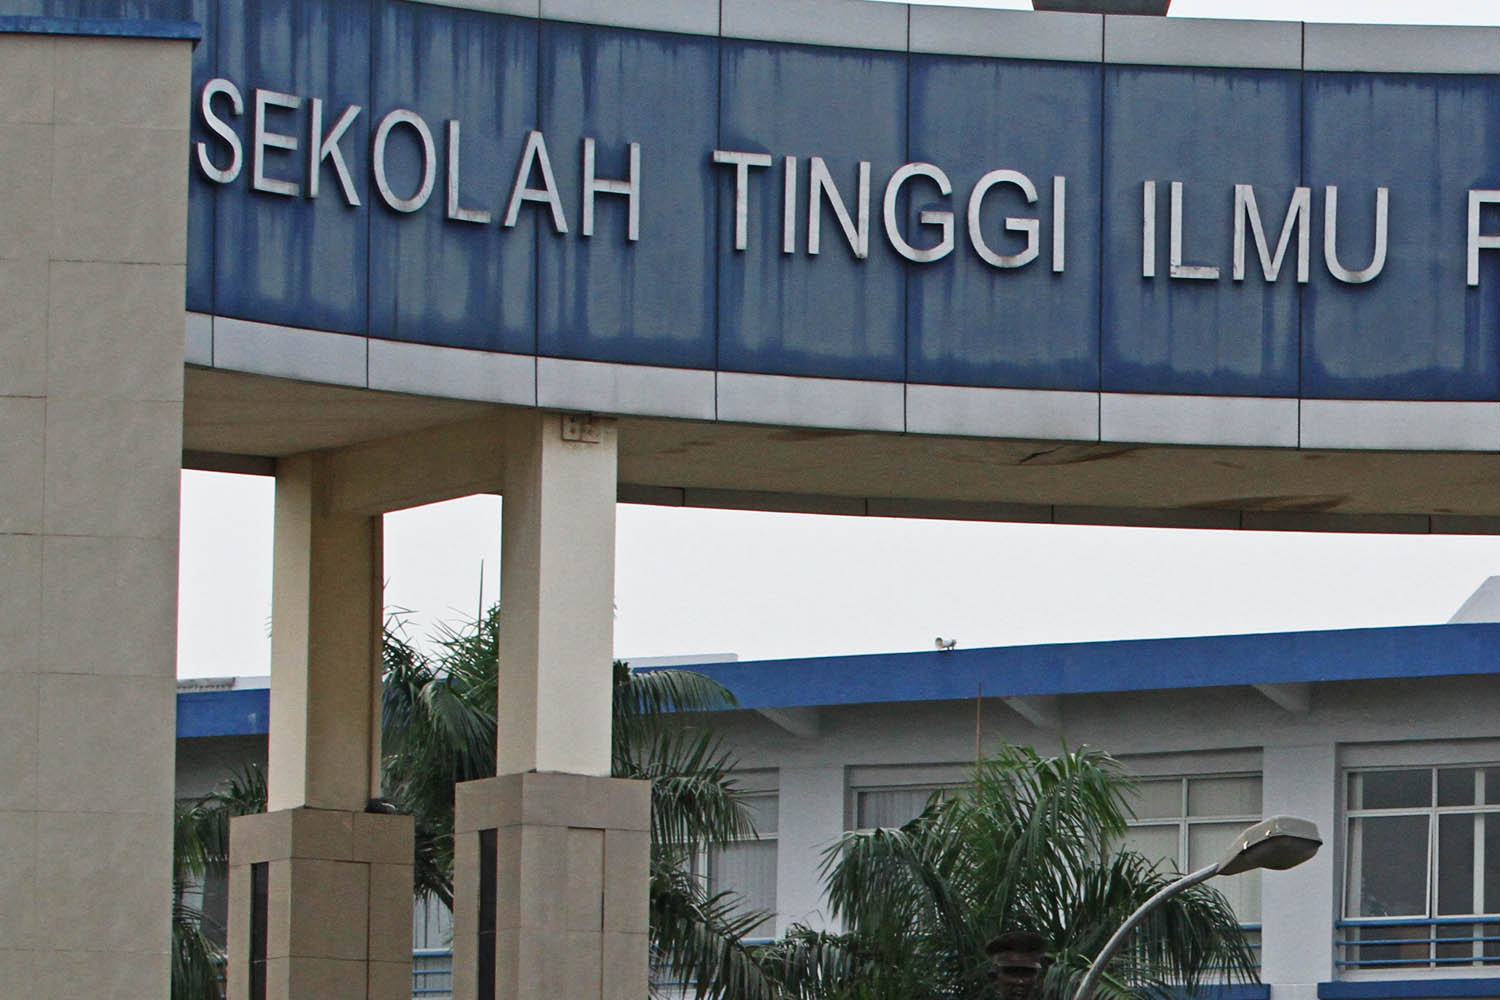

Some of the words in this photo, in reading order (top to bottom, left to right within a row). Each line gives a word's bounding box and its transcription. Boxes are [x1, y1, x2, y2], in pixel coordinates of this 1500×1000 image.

[196, 77, 641, 243] SEKOLAH
[713, 148, 1066, 274] TINGGI
[1143, 180, 1389, 285] ILMU
